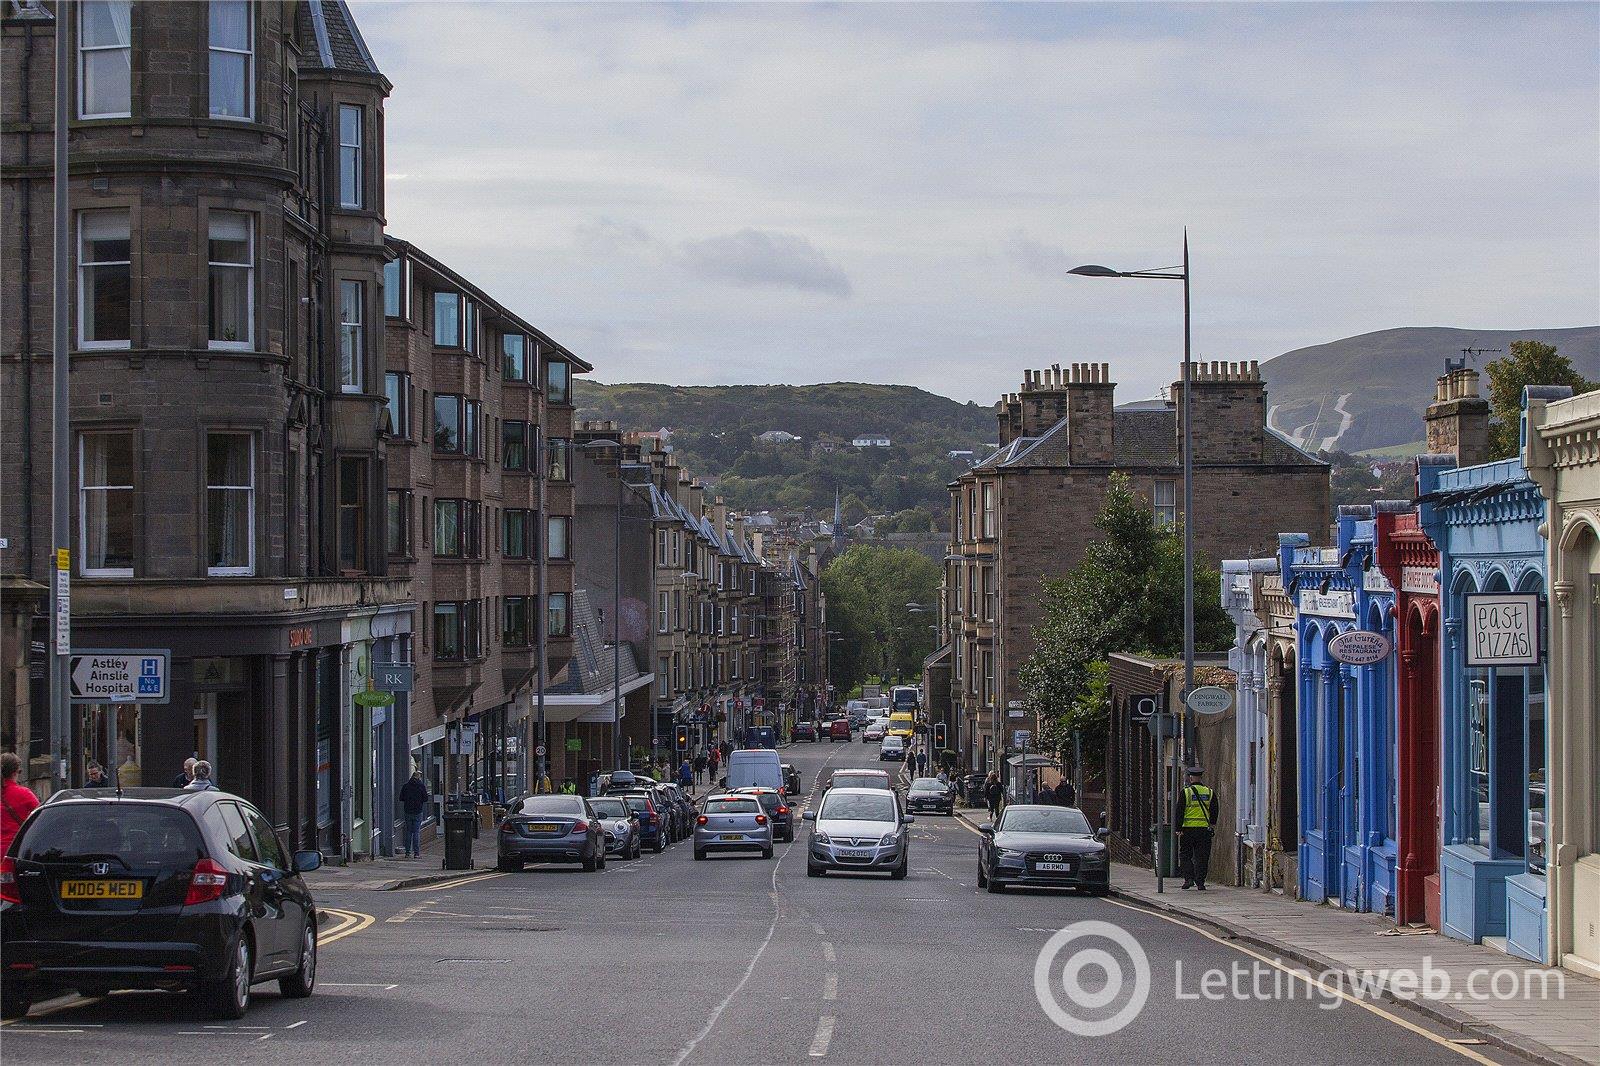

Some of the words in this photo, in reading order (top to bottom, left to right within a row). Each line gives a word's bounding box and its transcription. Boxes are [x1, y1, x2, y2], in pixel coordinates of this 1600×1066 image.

[1478, 606, 1523, 630] east
[1339, 636, 1353, 647] The
[1354, 633, 1383, 648] Gurkha
[1478, 632, 1528, 658] PIZZAS
[91, 658, 128, 671] Astley
[143, 660, 156, 675] H
[90, 671, 129, 680] Ainslie
[385, 673, 402, 684] RK
[86, 683, 134, 694] Hospital
